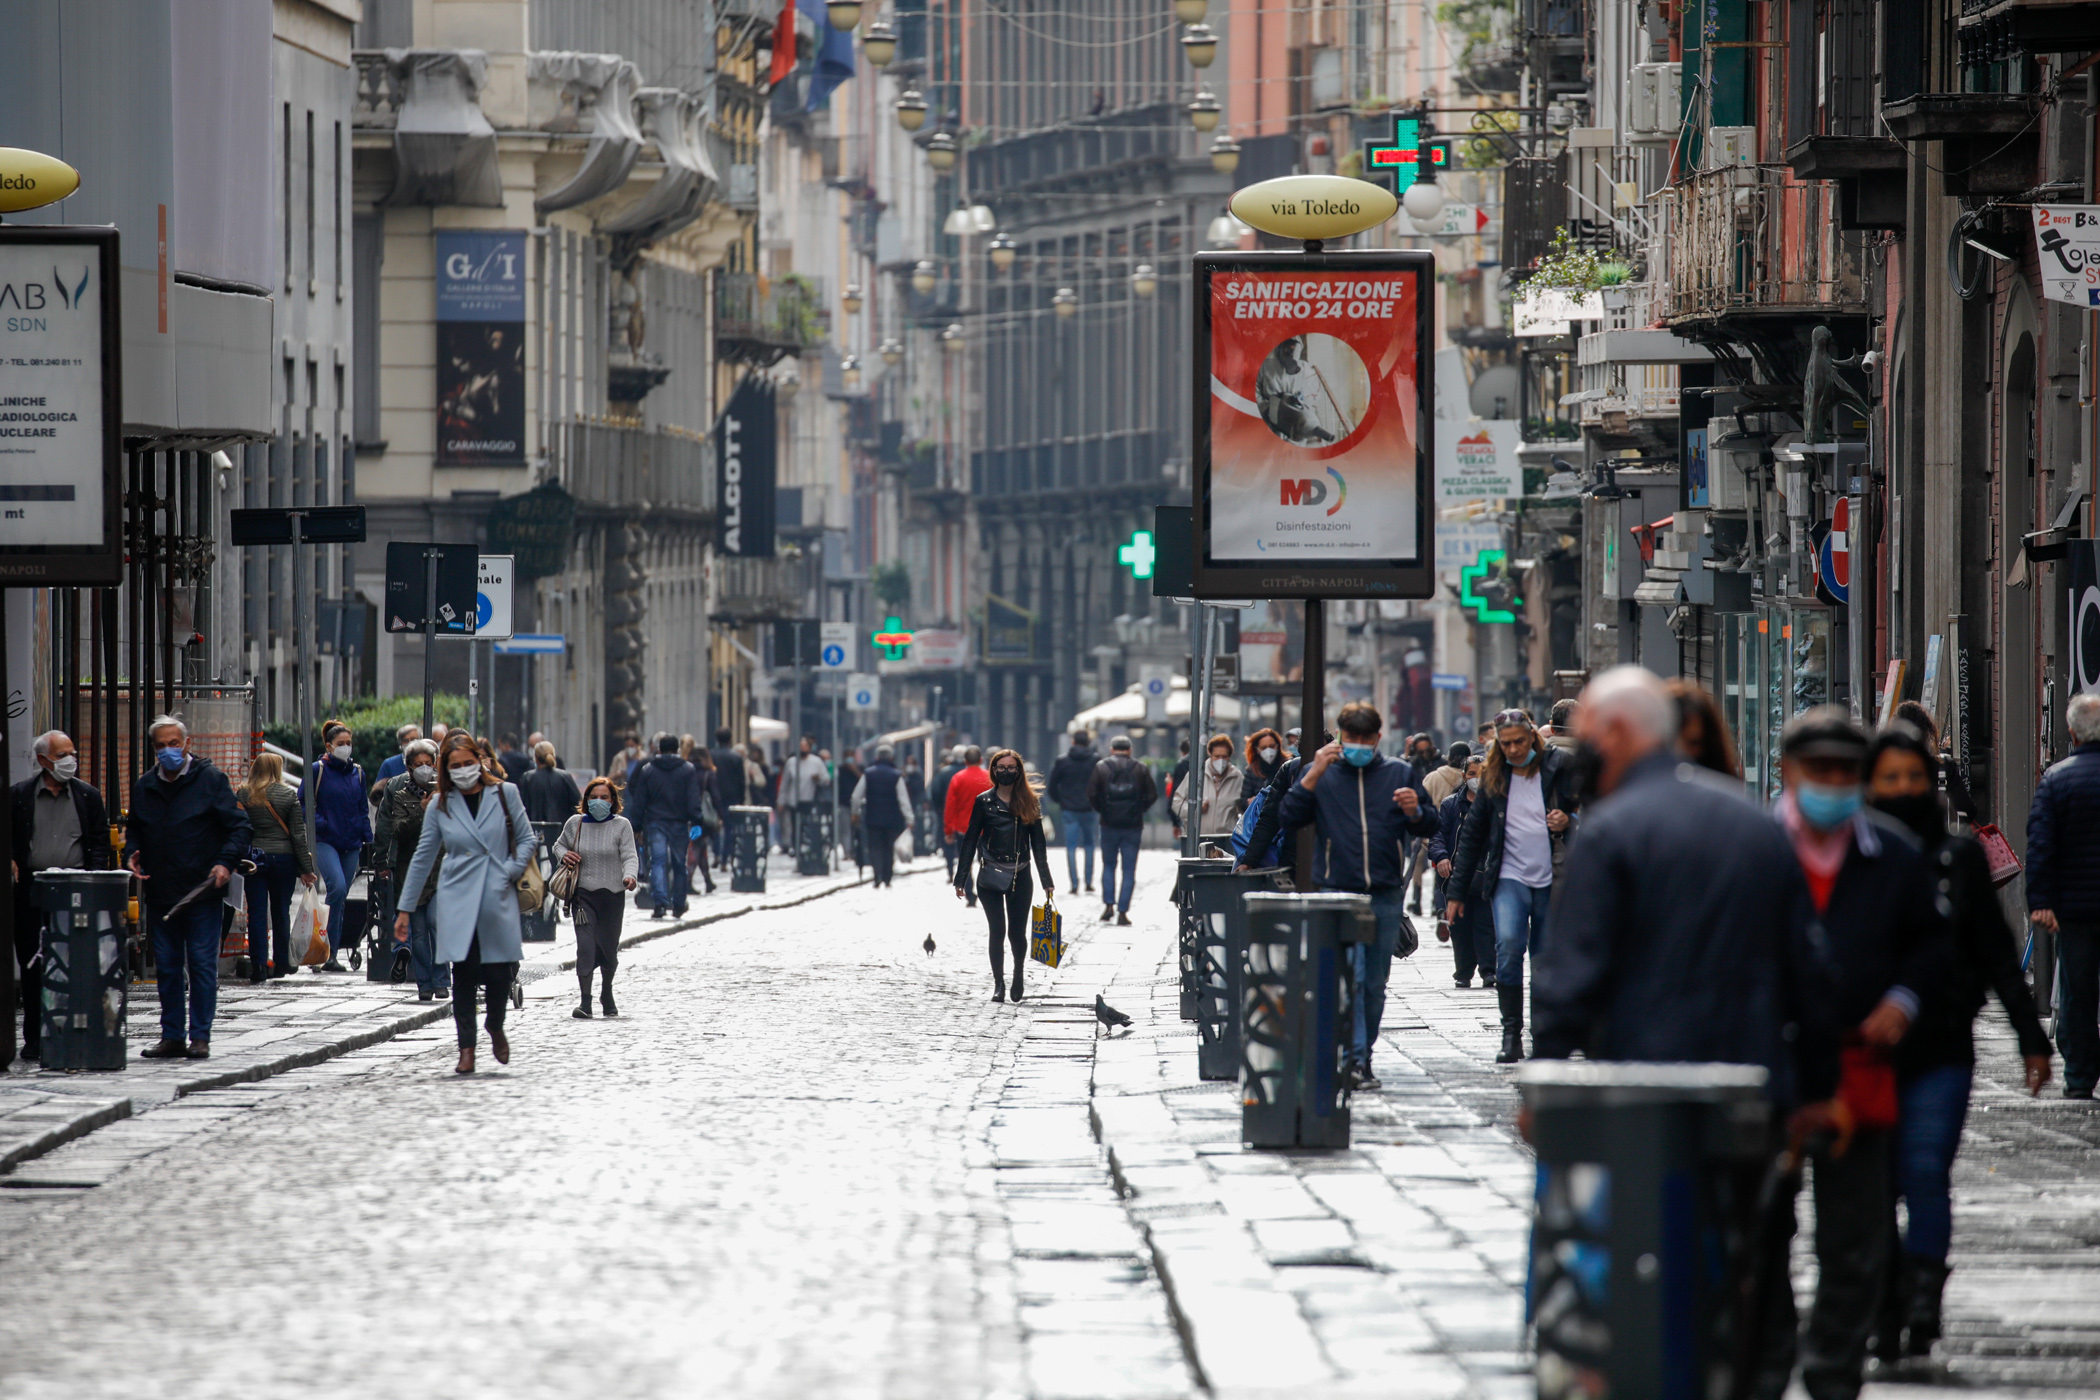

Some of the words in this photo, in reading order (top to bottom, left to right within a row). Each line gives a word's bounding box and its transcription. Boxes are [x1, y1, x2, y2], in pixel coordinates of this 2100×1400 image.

[1271, 199, 1297, 216] via
[1301, 199, 1360, 216] Toledo
[2038, 208, 2051, 227] 2
[2053, 216, 2072, 224] BEST
[1225, 281, 1403, 300] SANIFICAZIONE
[1234, 301, 1311, 319] ENTRO
[1314, 301, 1343, 319] 24
[1347, 301, 1395, 319] ORE
[7, 317, 47, 332] SDN
[61, 358, 71, 366] 81
[72, 358, 82, 366] 11
[0, 412, 78, 422] ADIOLOGICA
[447, 440, 516, 453] CARAVAGGIO
[725, 413, 742, 554] ALCOTT
[1280, 479, 1327, 505] MD
[5, 508, 25, 519] mt
[1276, 521, 1352, 531] Disinfestazioni
[1319, 578, 1365, 588] NAPOLI
